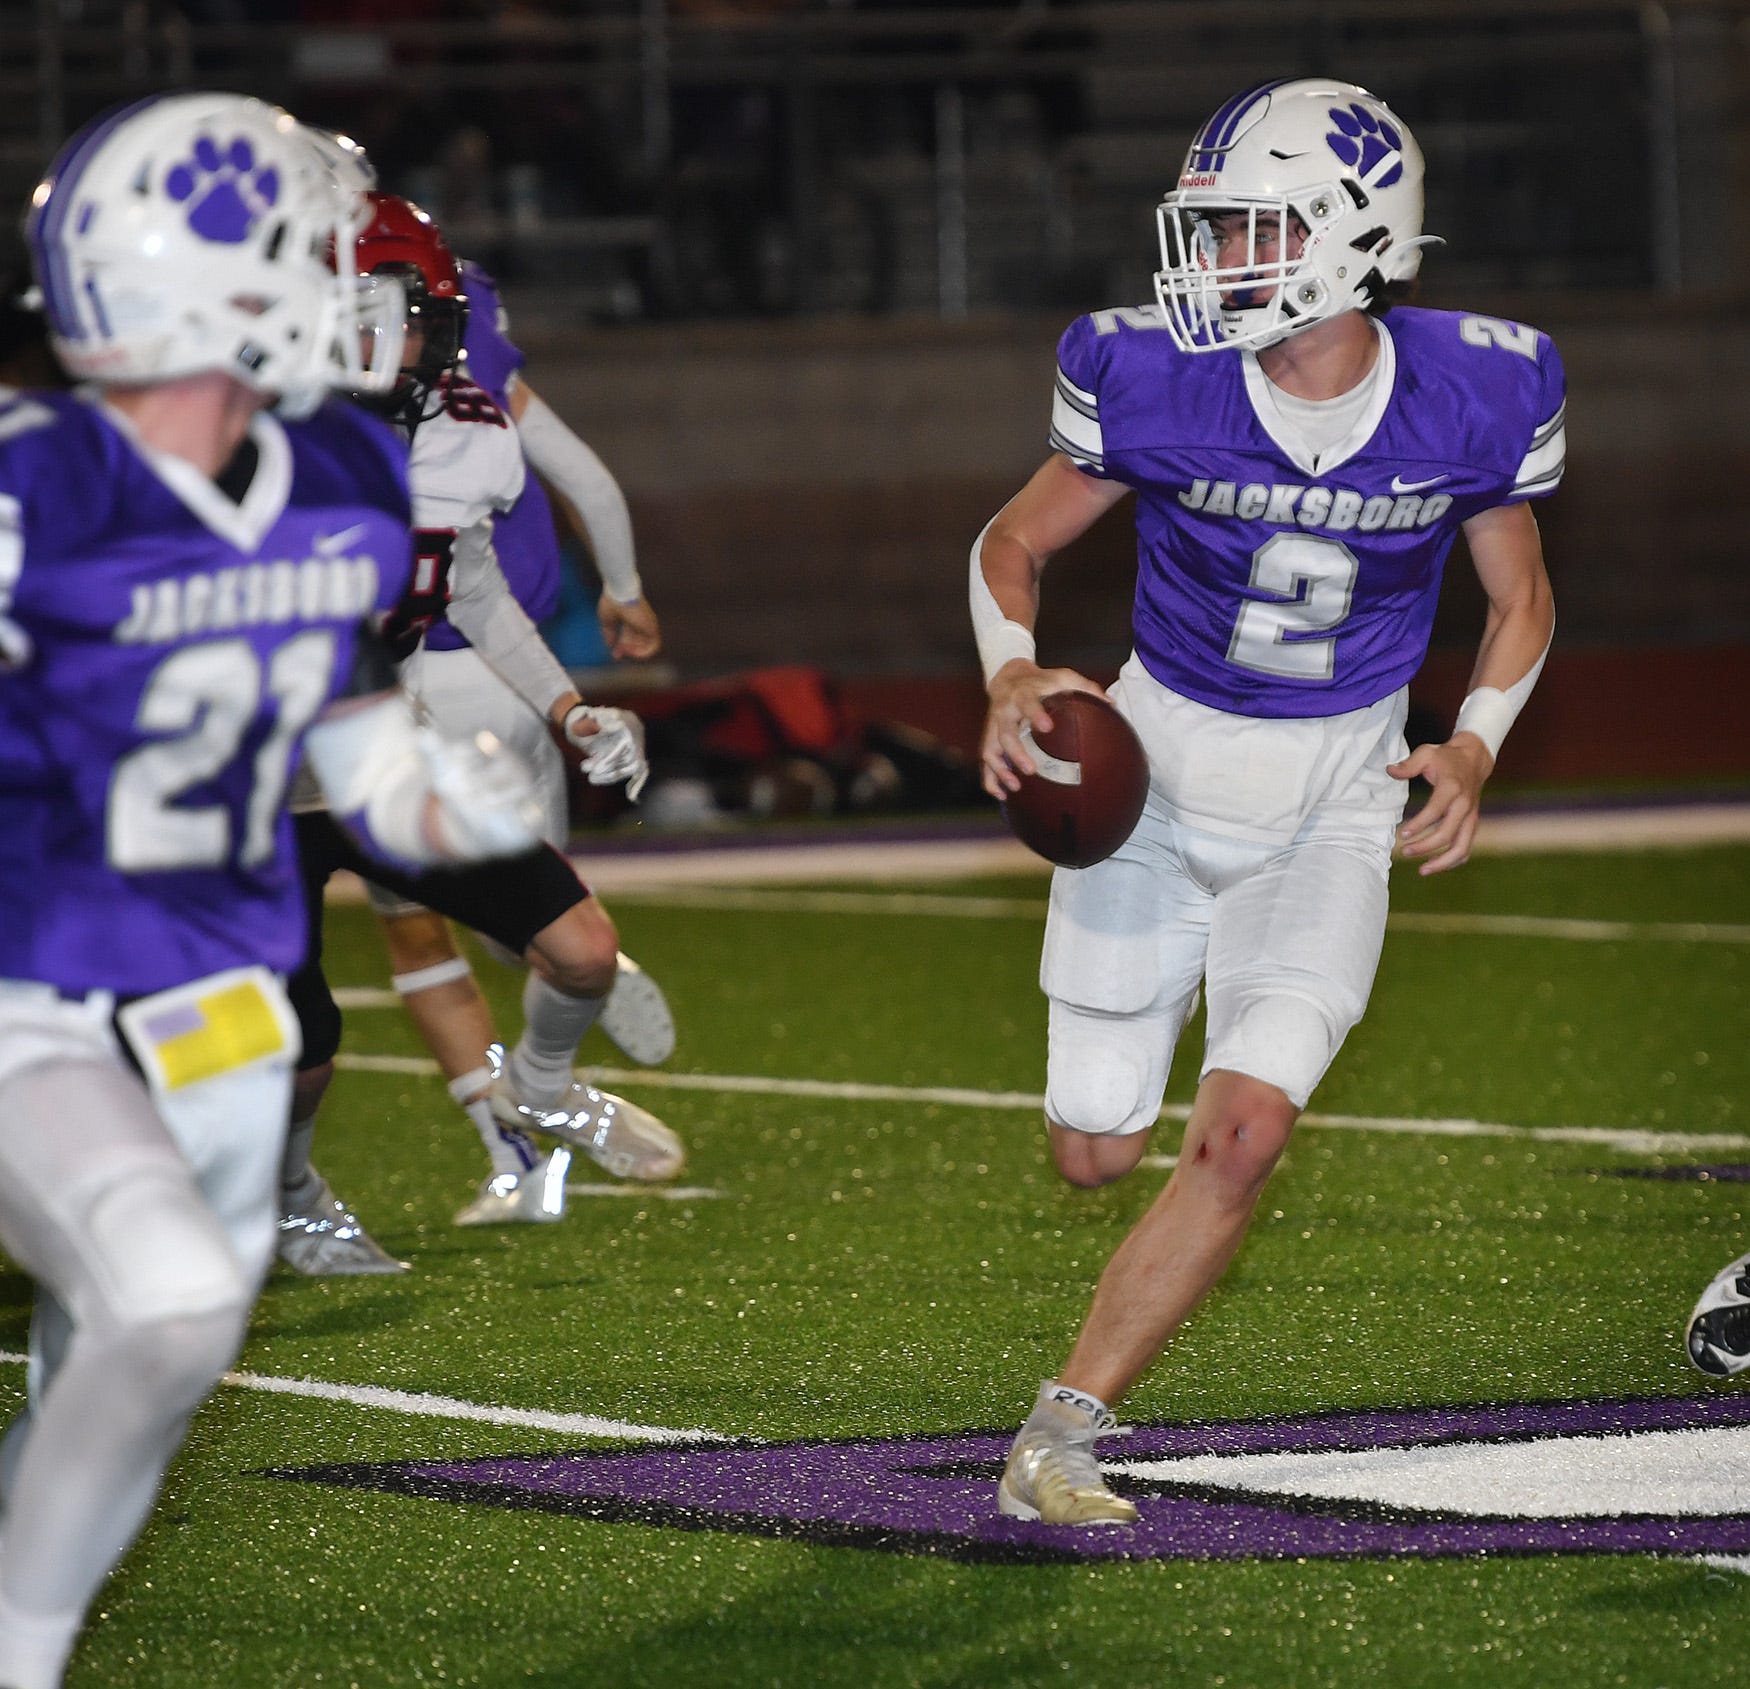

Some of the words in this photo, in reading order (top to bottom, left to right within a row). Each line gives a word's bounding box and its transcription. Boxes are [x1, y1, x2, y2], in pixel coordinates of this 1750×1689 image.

[1460, 317, 1539, 361] 2
[1178, 478, 1454, 531] JACKSBORO
[1225, 531, 1360, 680] 2
[107, 629, 338, 874] 21
